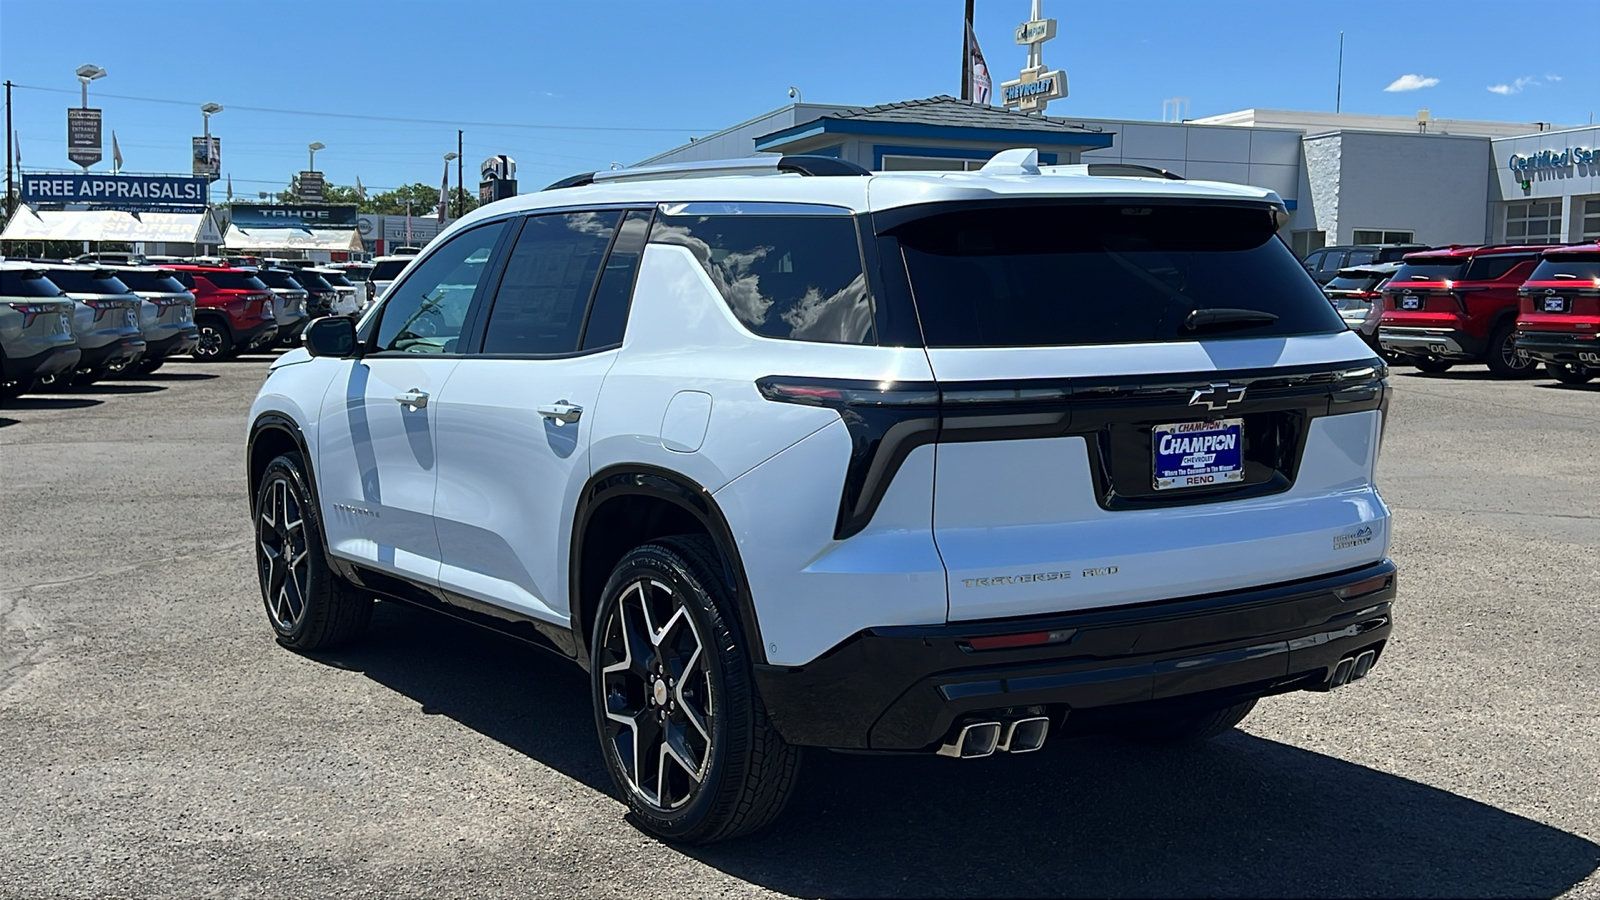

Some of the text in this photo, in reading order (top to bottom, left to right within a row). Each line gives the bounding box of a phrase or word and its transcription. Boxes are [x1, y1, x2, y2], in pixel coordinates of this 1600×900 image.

[1005, 79, 1052, 100] CHEVROLET
[1509, 148, 1571, 171] Certified
[28, 180, 201, 199] FREE APPRAISALS!
[258, 209, 330, 219] TAHOE
[134, 223, 194, 233] OFFER
[1178, 421, 1221, 433] CHAMPION
[1159, 434, 1236, 456] CHAMPION
[1183, 455, 1214, 463] CHEVROLET
[1178, 468, 1187, 476] The
[1186, 475, 1215, 486] RENO
[961, 565, 1120, 588] TRAVERSE AWD
